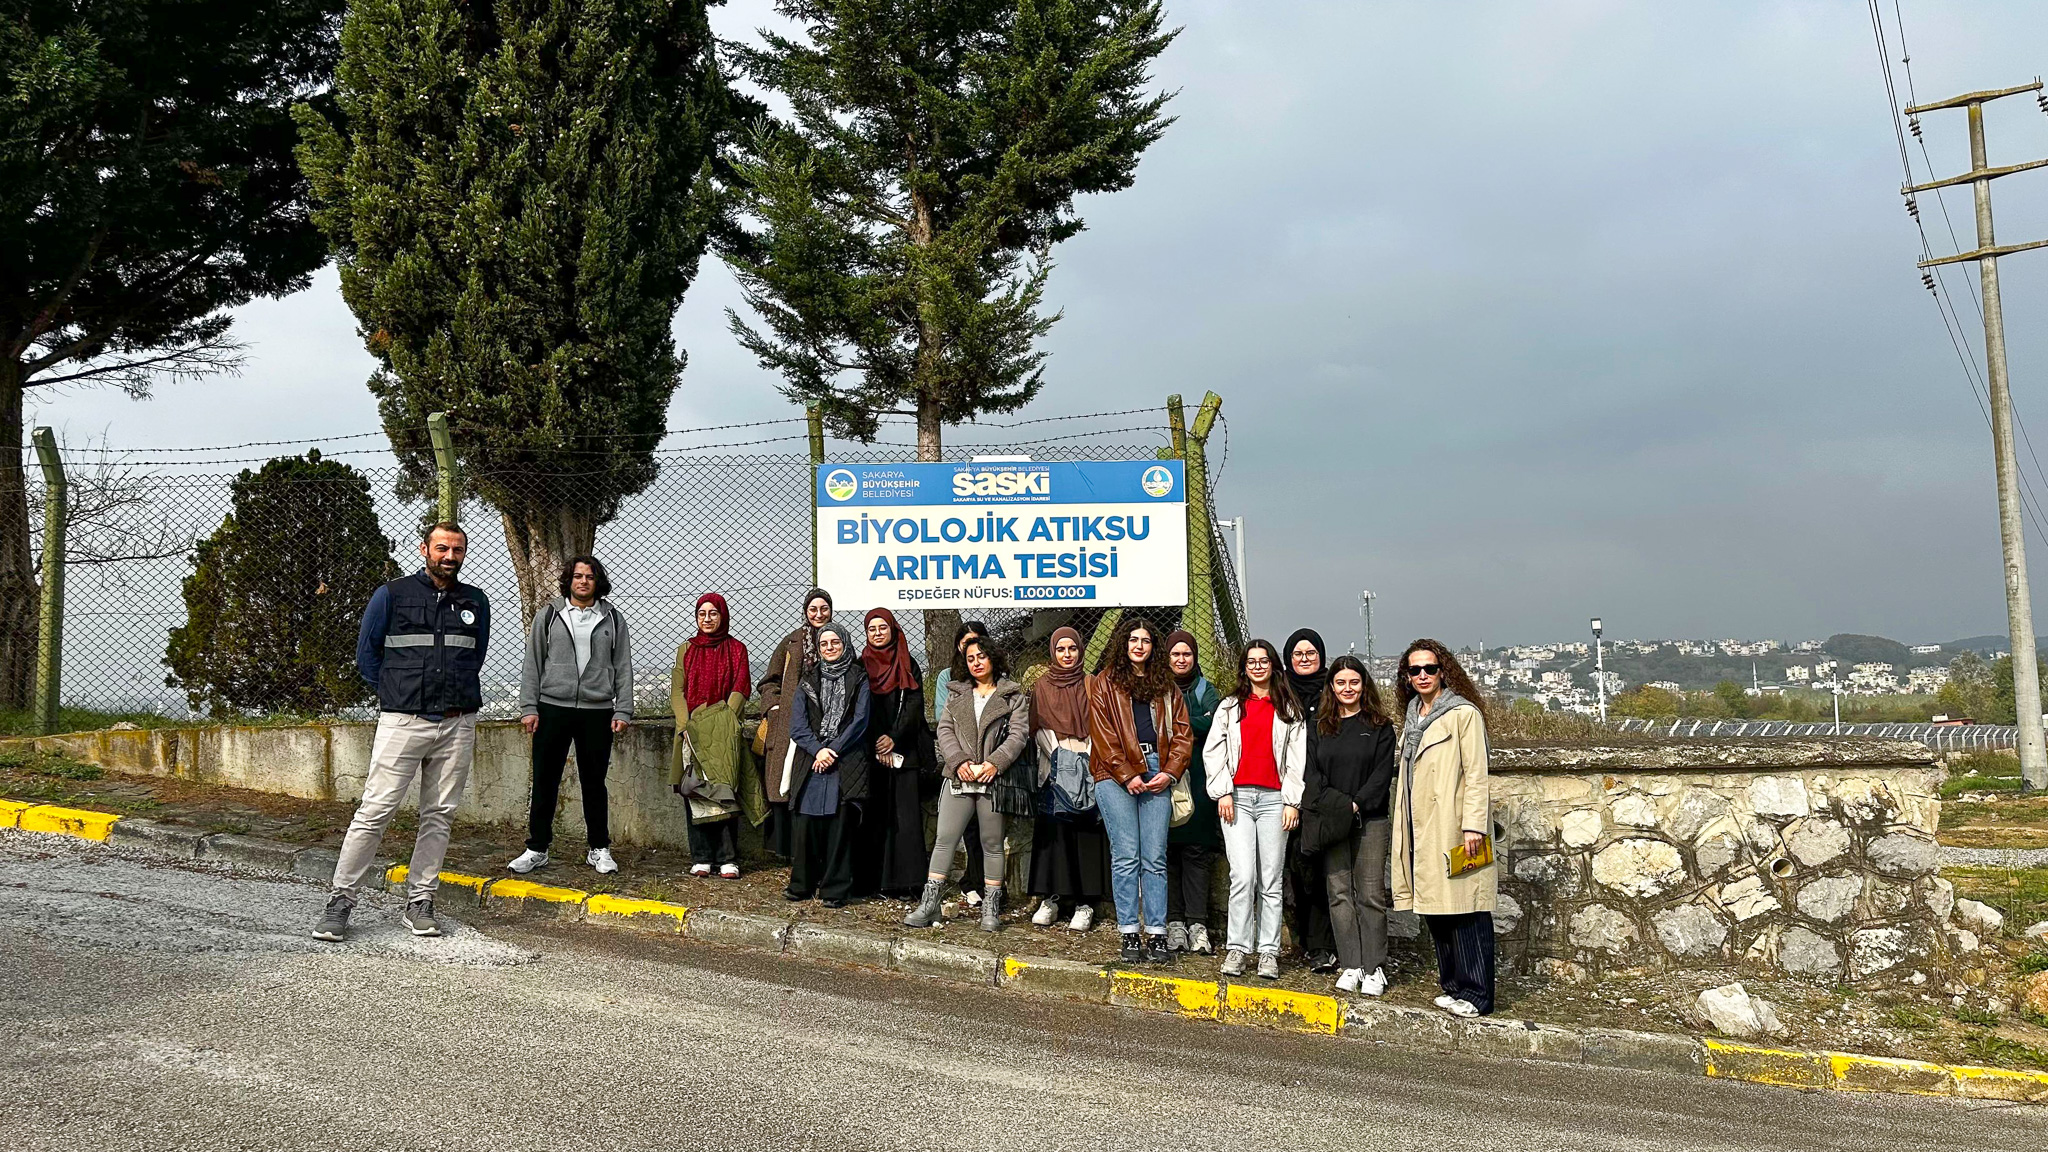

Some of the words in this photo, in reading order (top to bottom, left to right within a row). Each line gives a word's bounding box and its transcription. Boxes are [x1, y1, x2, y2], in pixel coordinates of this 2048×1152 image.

[862, 471, 905, 479] SAKARYA
[862, 479, 920, 488] BÜYÜKŞEHİR
[862, 489, 914, 498] BELEDİYESİ
[837, 511, 1019, 544] BİYOLOJİK
[1027, 516, 1150, 542] ATIKSU
[869, 554, 1006, 580] ARITMA
[1014, 546, 1118, 578] TESİSİ
[898, 586, 960, 601] EŞDEĞER
[964, 586, 1013, 598] NÜFUS:
[1018, 587, 1055, 598] 1.000
[1058, 586, 1086, 598] 000
